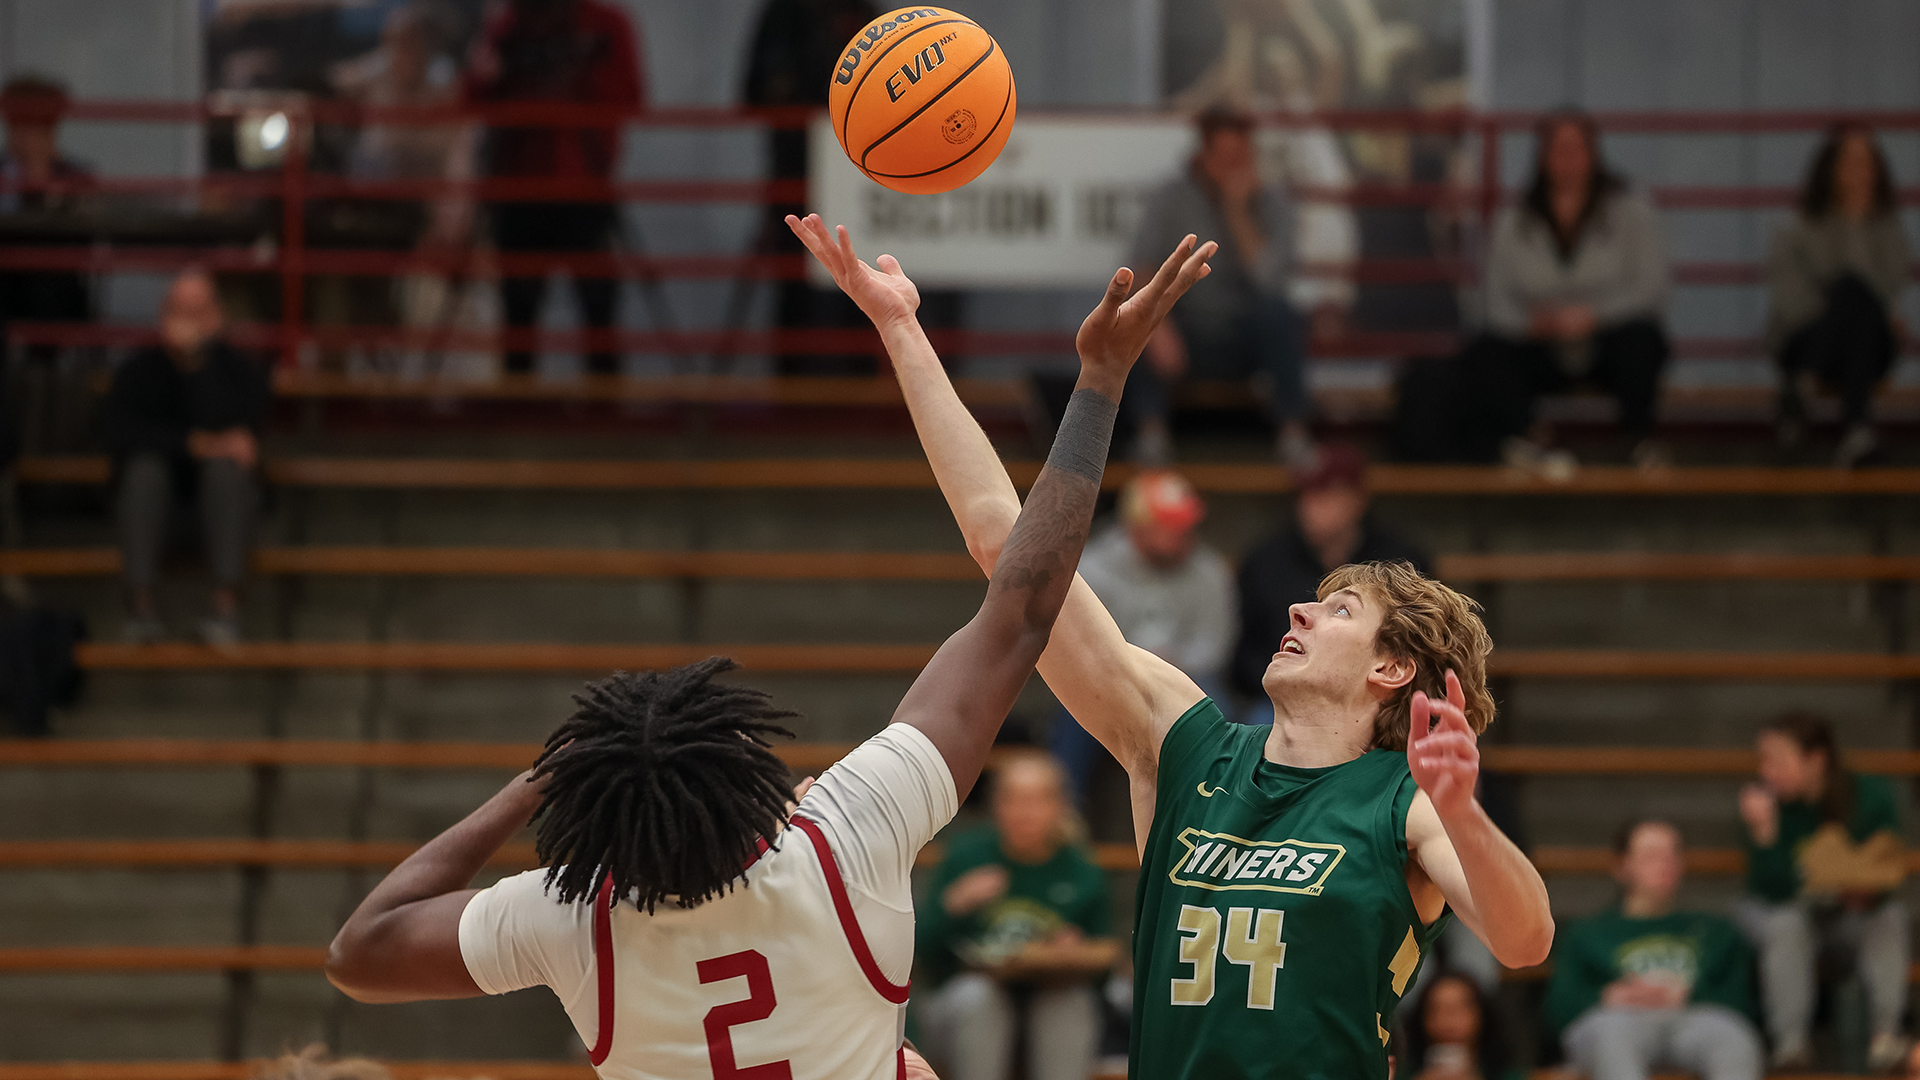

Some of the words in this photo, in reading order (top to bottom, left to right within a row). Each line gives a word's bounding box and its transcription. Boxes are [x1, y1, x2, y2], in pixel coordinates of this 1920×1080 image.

[835, 8, 941, 86] Wilson
[884, 41, 945, 104] EVO
[940, 31, 958, 46] NXT
[1170, 904, 1287, 1010] 34
[696, 948, 794, 1080] 2
